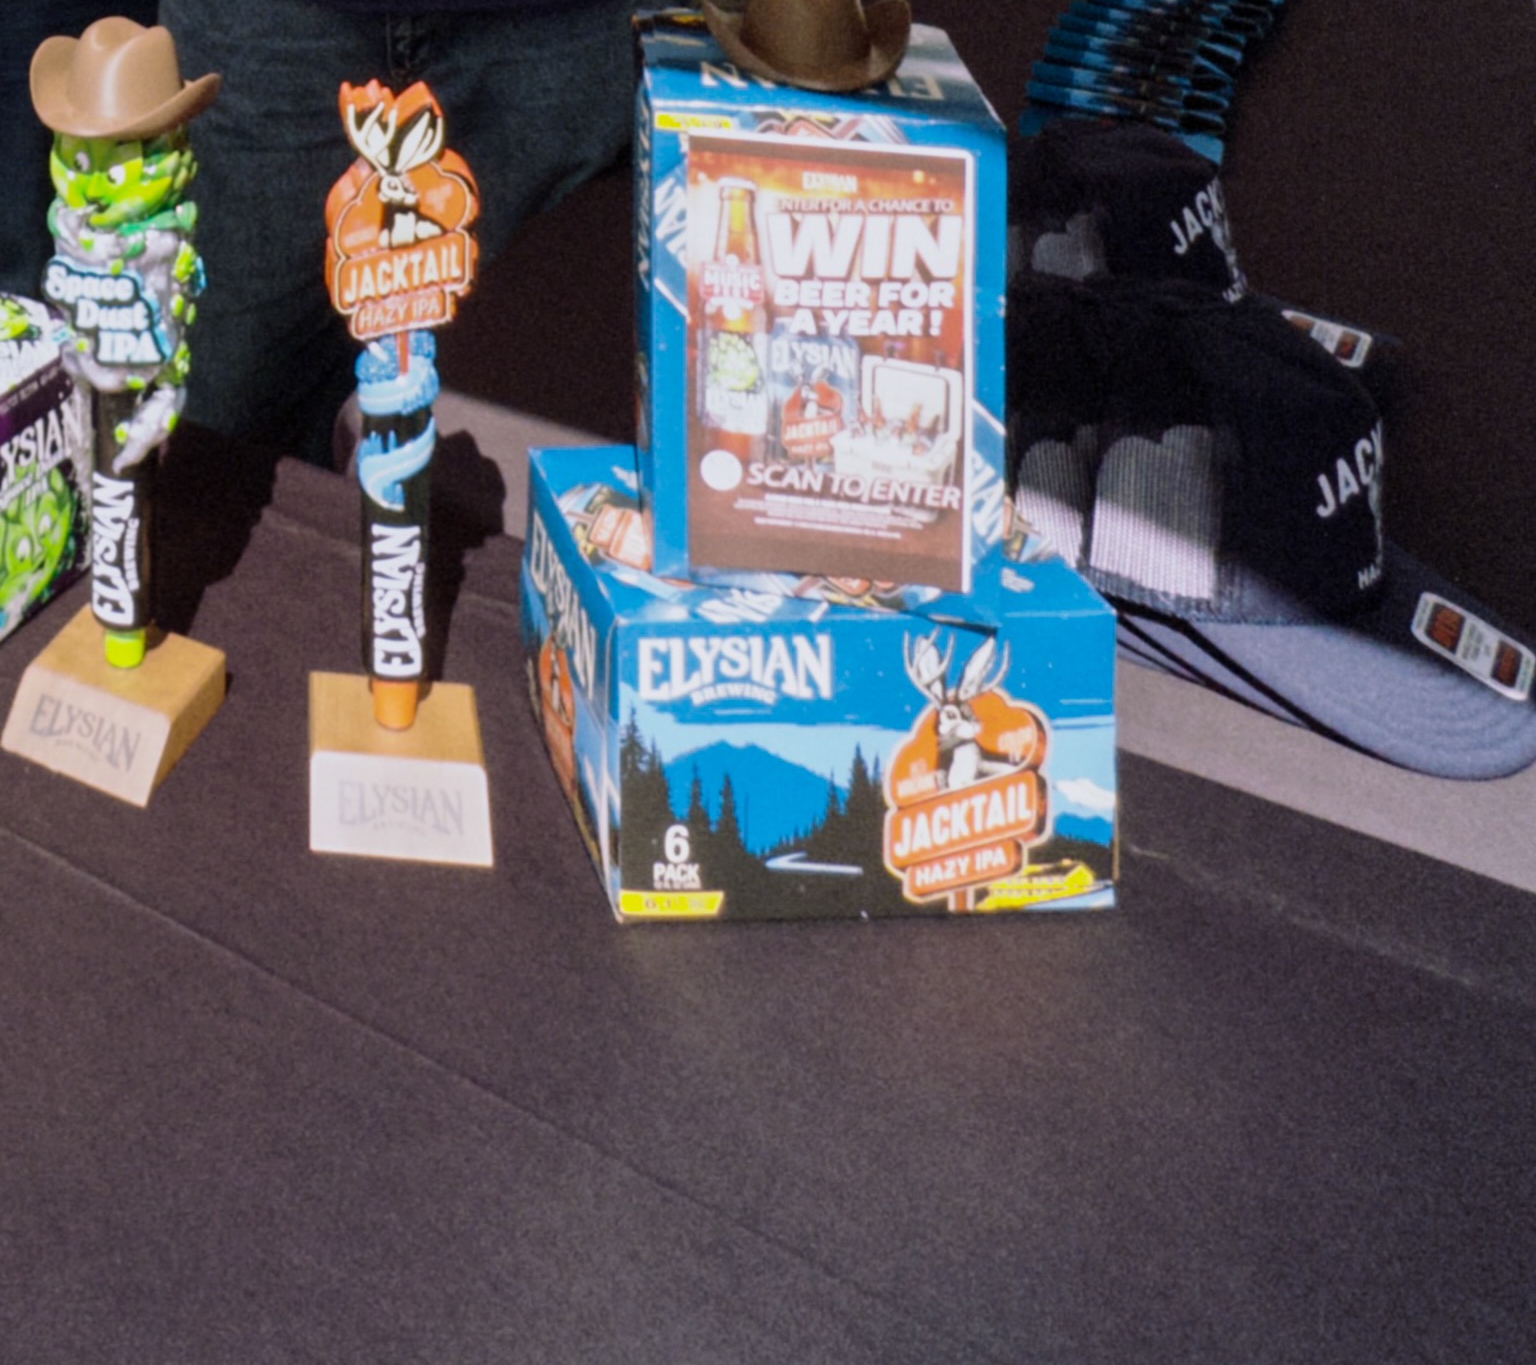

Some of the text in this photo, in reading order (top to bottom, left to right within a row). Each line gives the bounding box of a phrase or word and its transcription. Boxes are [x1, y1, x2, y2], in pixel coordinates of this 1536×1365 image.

[868, 198, 931, 213] CHANCE
[933, 198, 955, 213] TO
[767, 214, 962, 280] WIN
[45, 265, 136, 300] Space
[344, 243, 463, 303] JACKTAIL
[75, 298, 152, 329] Dust
[360, 299, 440, 329] HAZY IPA
[774, 281, 955, 308] BEER FOR
[789, 310, 818, 334] A
[97, 331, 163, 365] IPA
[747, 463, 824, 493] SCAN
[872, 480, 962, 511] ENTER
[92, 471, 135, 627] ELYSIAN
[370, 523, 423, 677] ELYSIAN
[529, 511, 598, 701] ELYSIAN
[637, 634, 834, 700] ELYSIAN
[691, 680, 778, 706] BREWING
[28, 692, 142, 772] ELYSIAN
[337, 780, 463, 836] ELYSIAN
[893, 782, 1033, 858] JACKTAIL
[663, 824, 691, 864] 6
[652, 862, 701, 883] PACK
[914, 855, 971, 888] HAZY
[974, 846, 1008, 873] IPA
